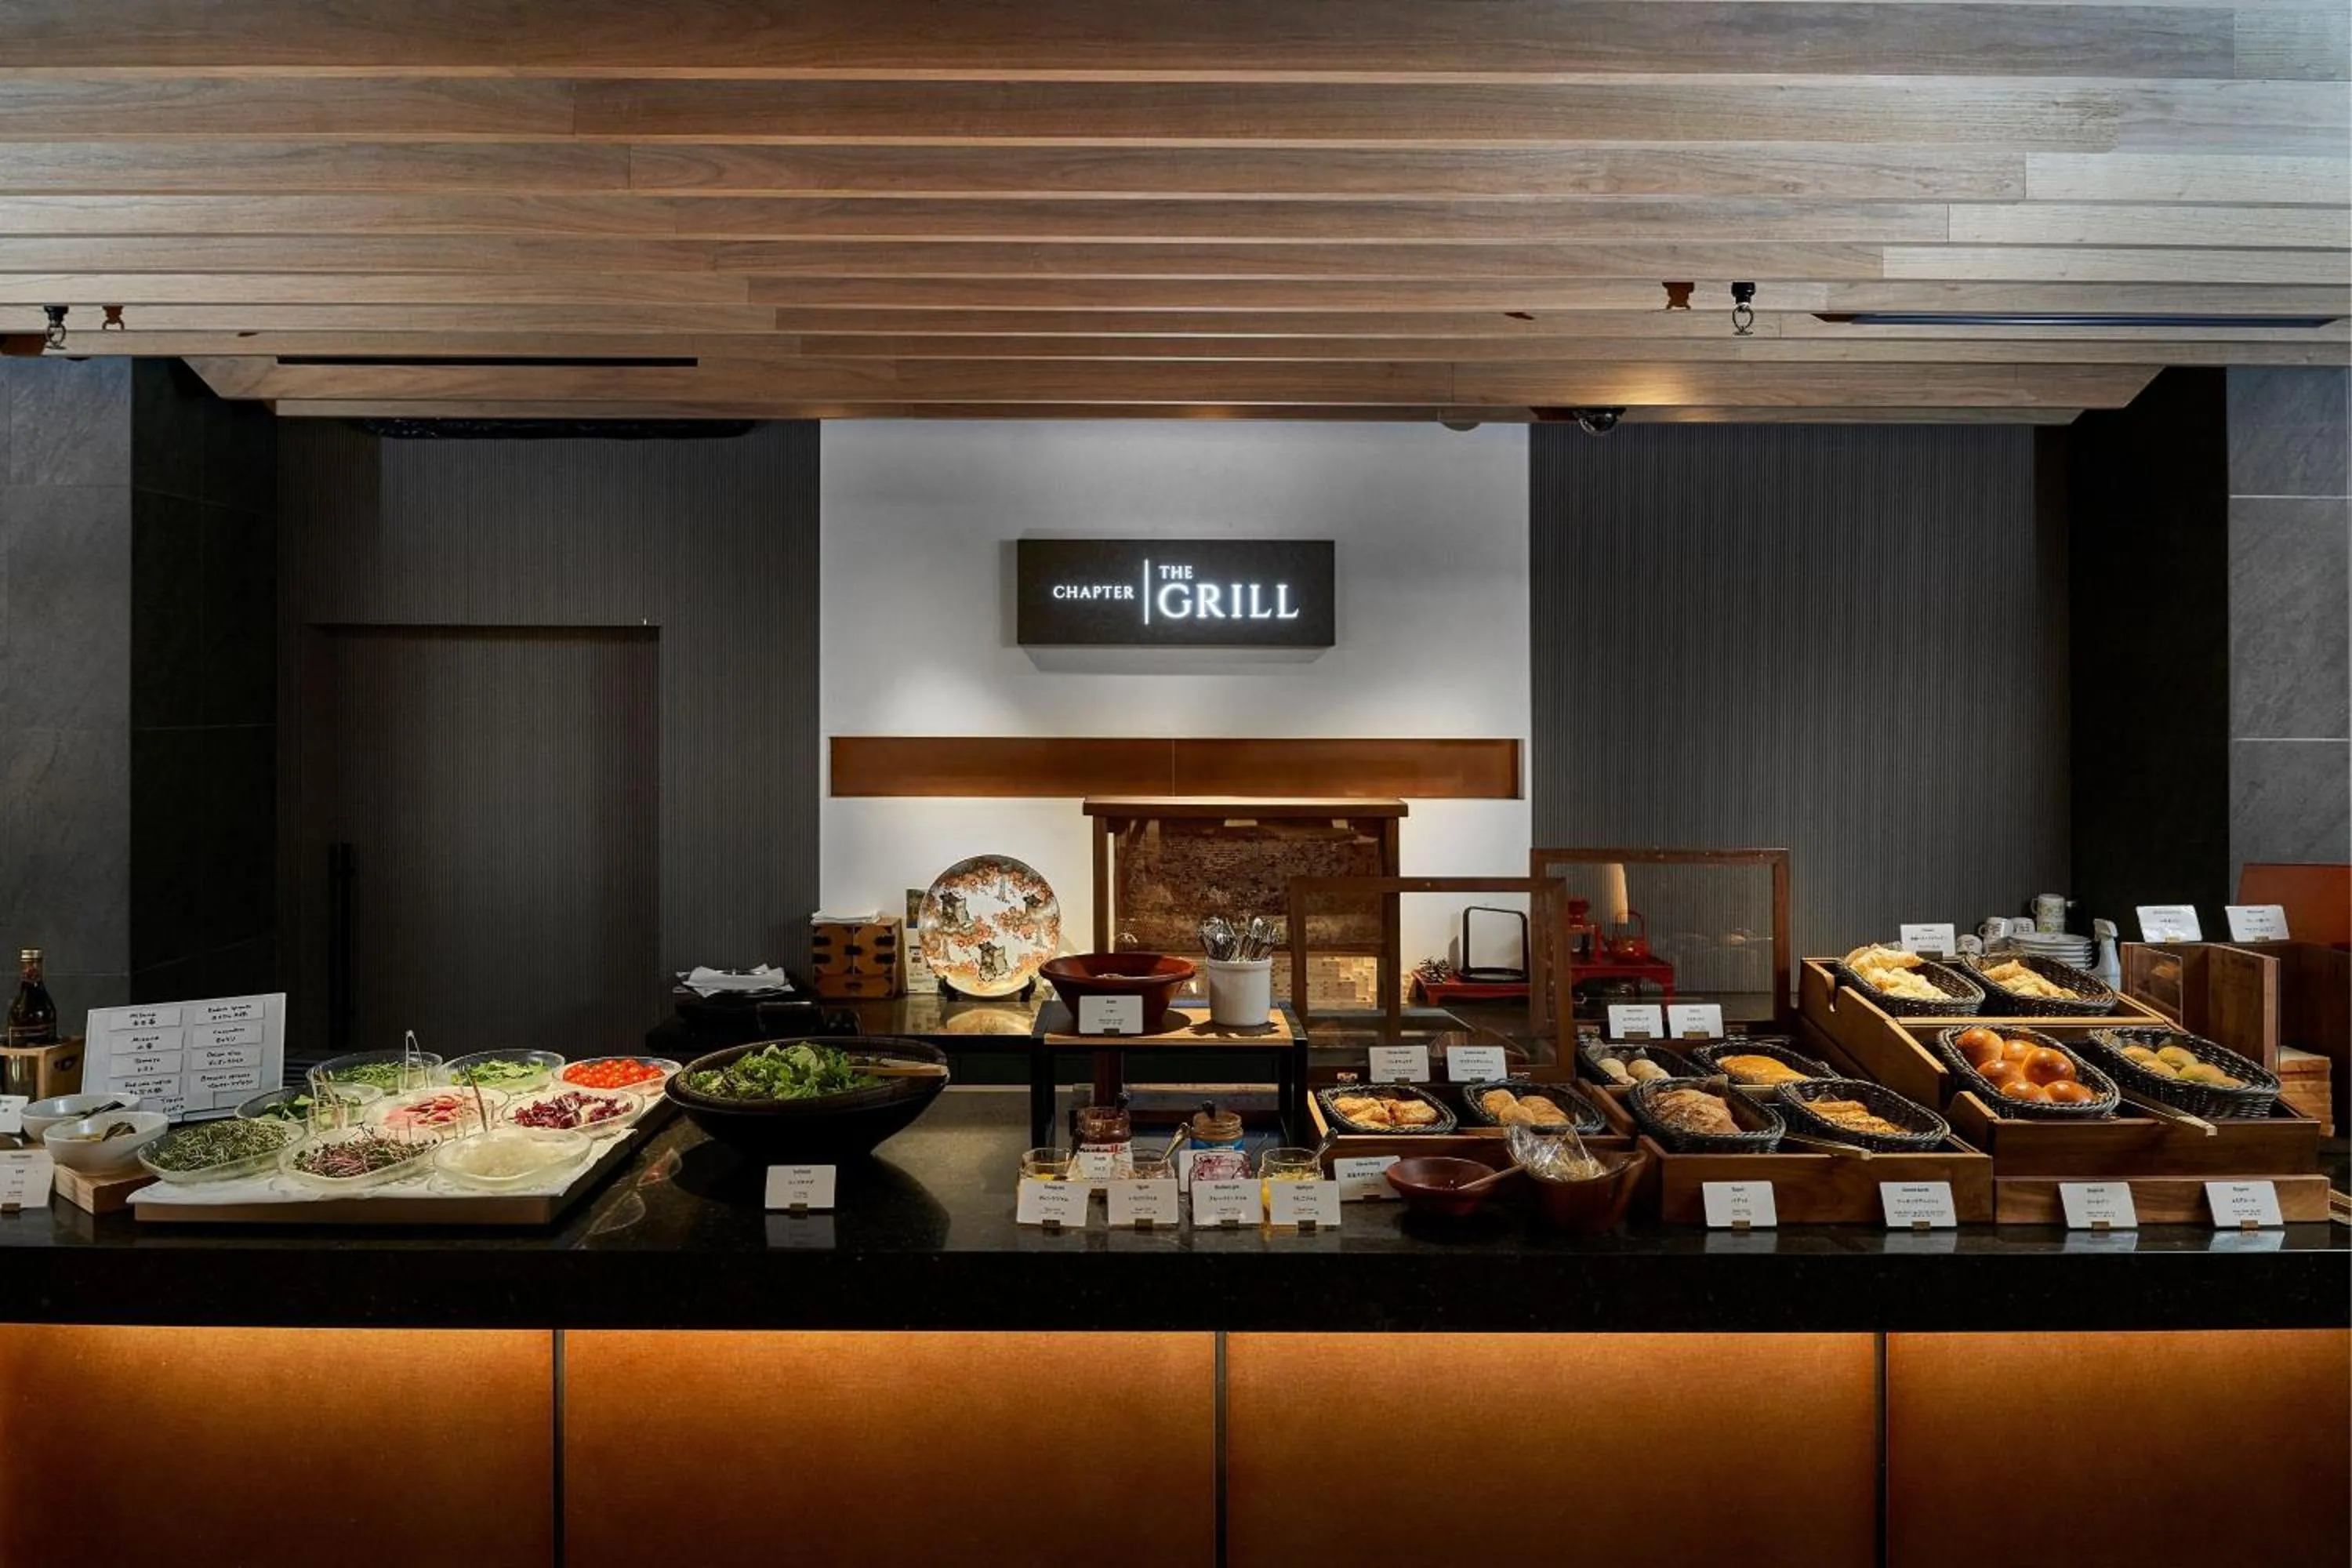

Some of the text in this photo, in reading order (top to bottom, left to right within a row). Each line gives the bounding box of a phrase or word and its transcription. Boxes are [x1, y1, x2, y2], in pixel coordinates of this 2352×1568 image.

[1158, 564, 1193, 579] THE
[1053, 585, 1135, 600] CHAPTER
[1157, 582, 1299, 619] GRILL
